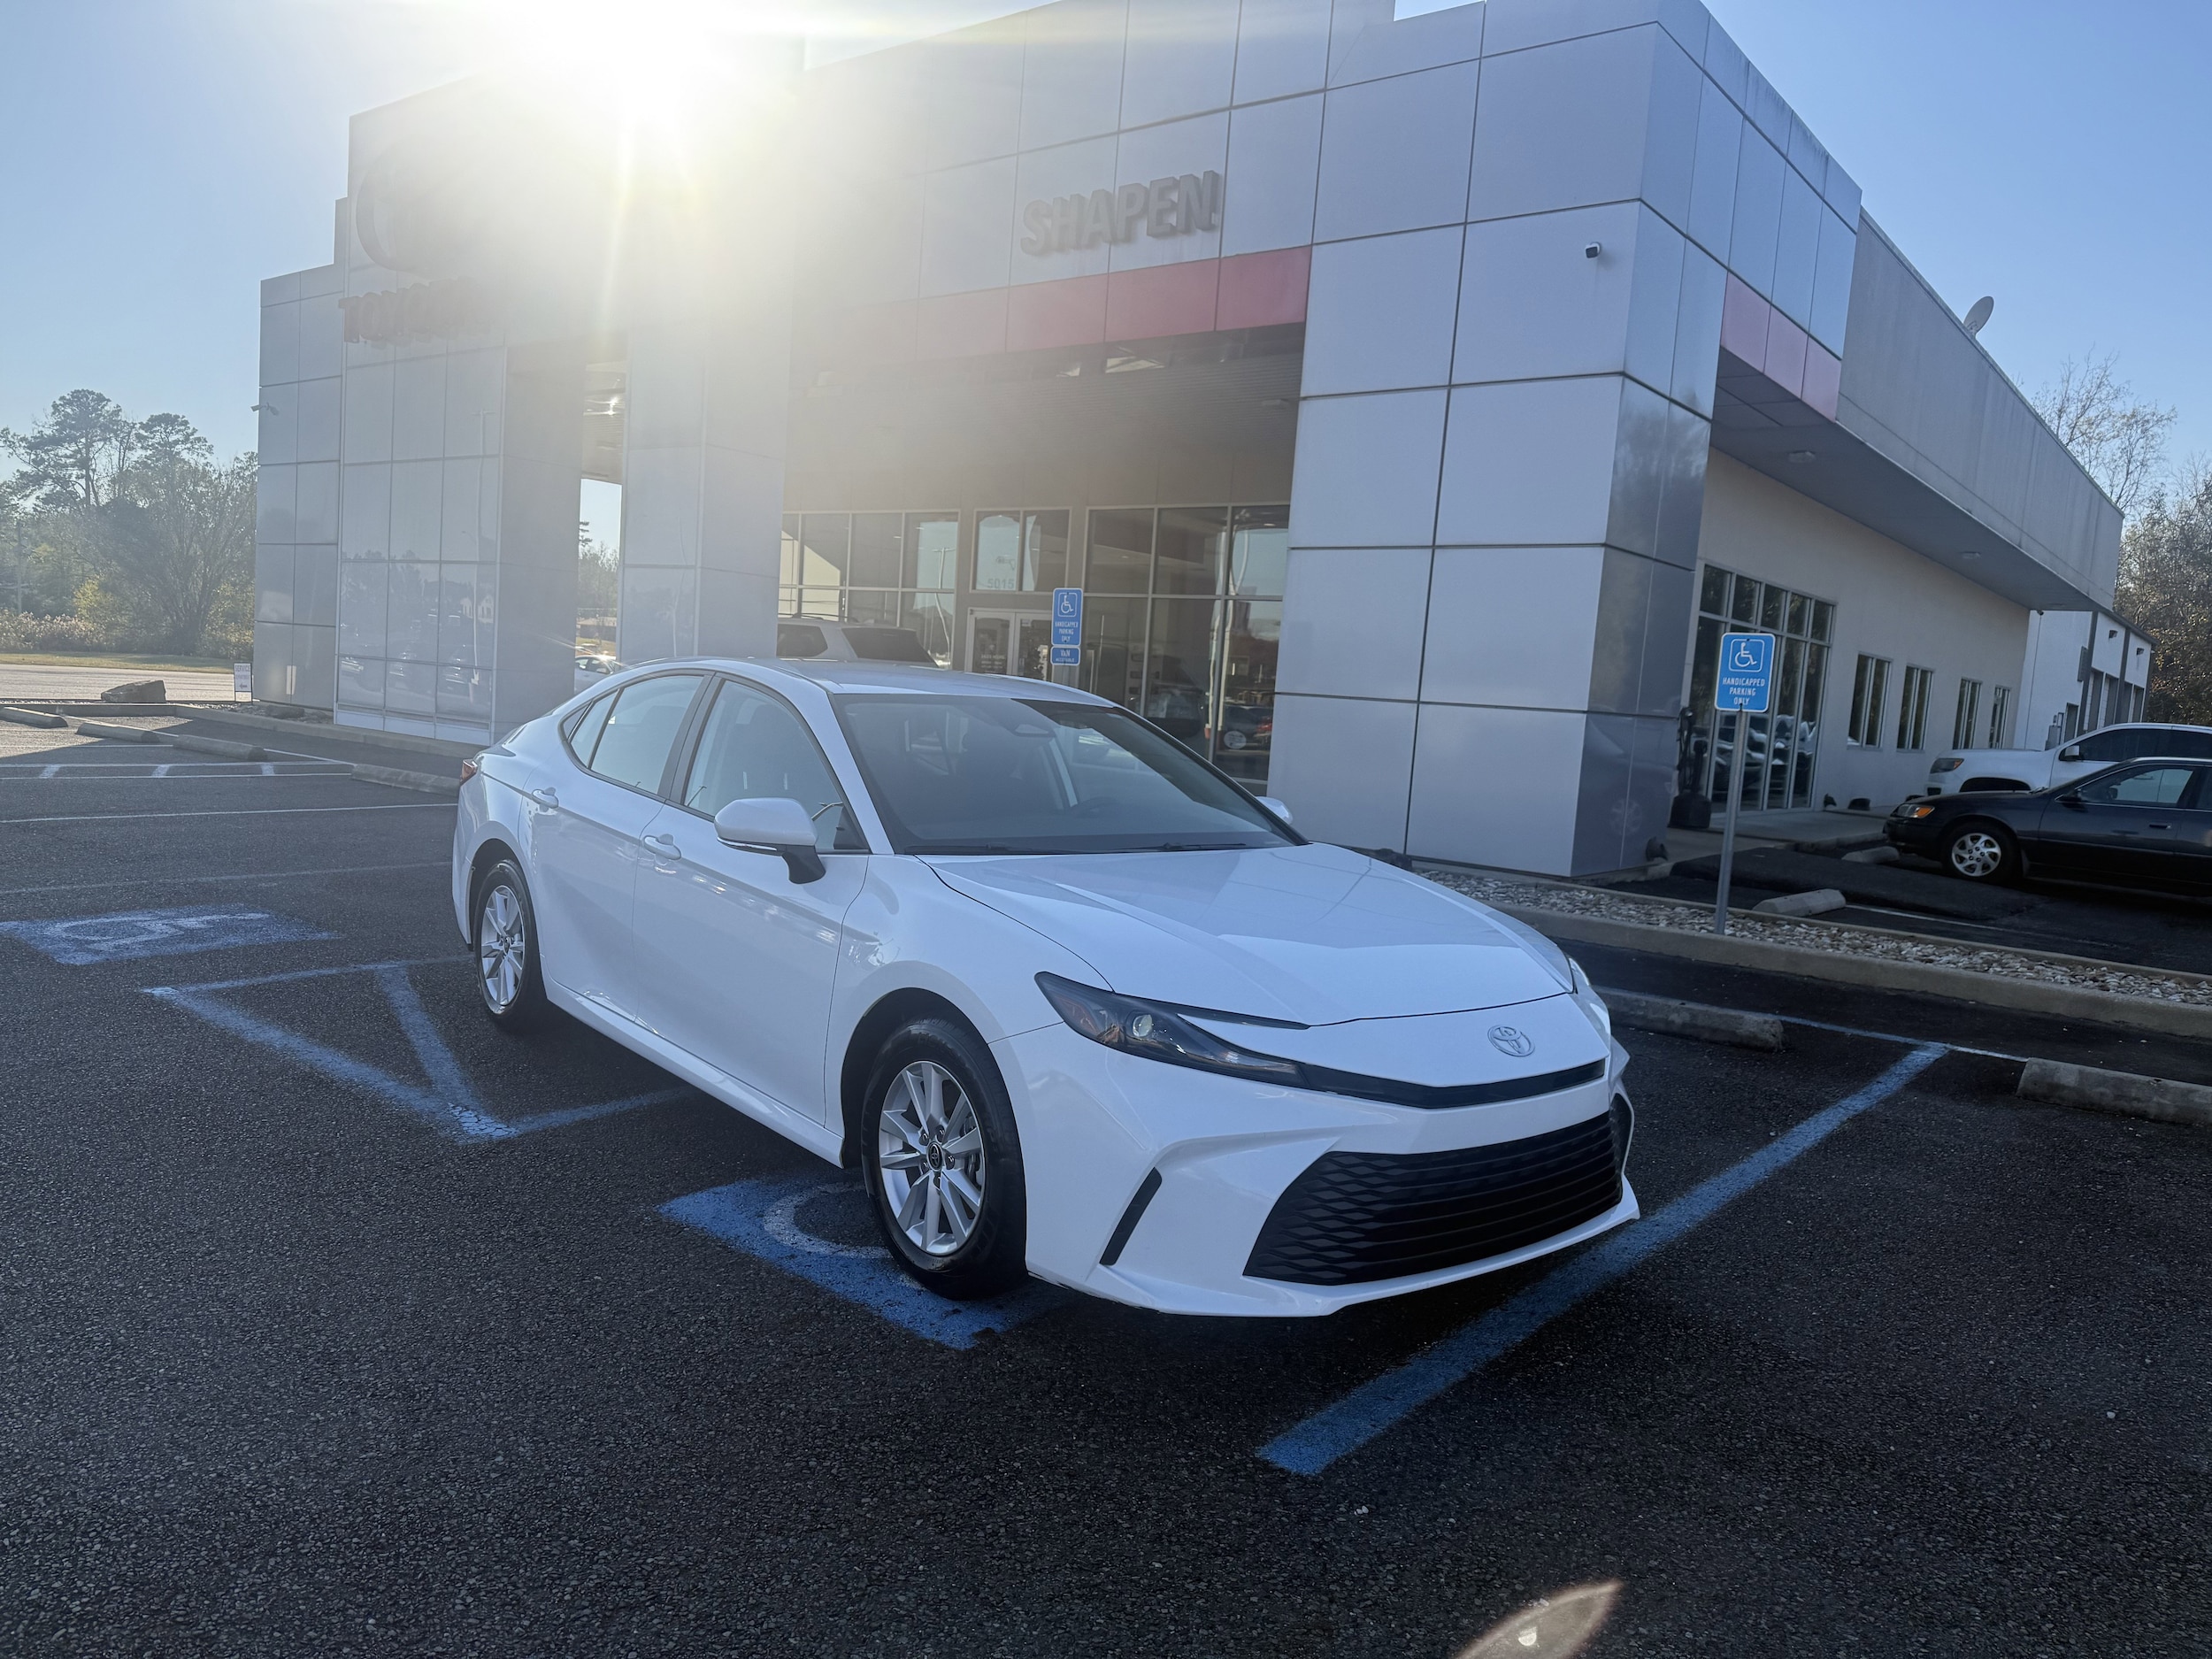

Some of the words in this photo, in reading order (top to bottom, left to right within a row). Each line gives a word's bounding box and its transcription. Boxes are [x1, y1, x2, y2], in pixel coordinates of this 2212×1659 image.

[1020, 170, 1220, 256] SHAPEN
[338, 275, 491, 345] TOYO
[987, 578, 1015, 589] 5015
[1723, 678, 1765, 687] HANDICAPPED
[1729, 687, 1756, 696] PARKING
